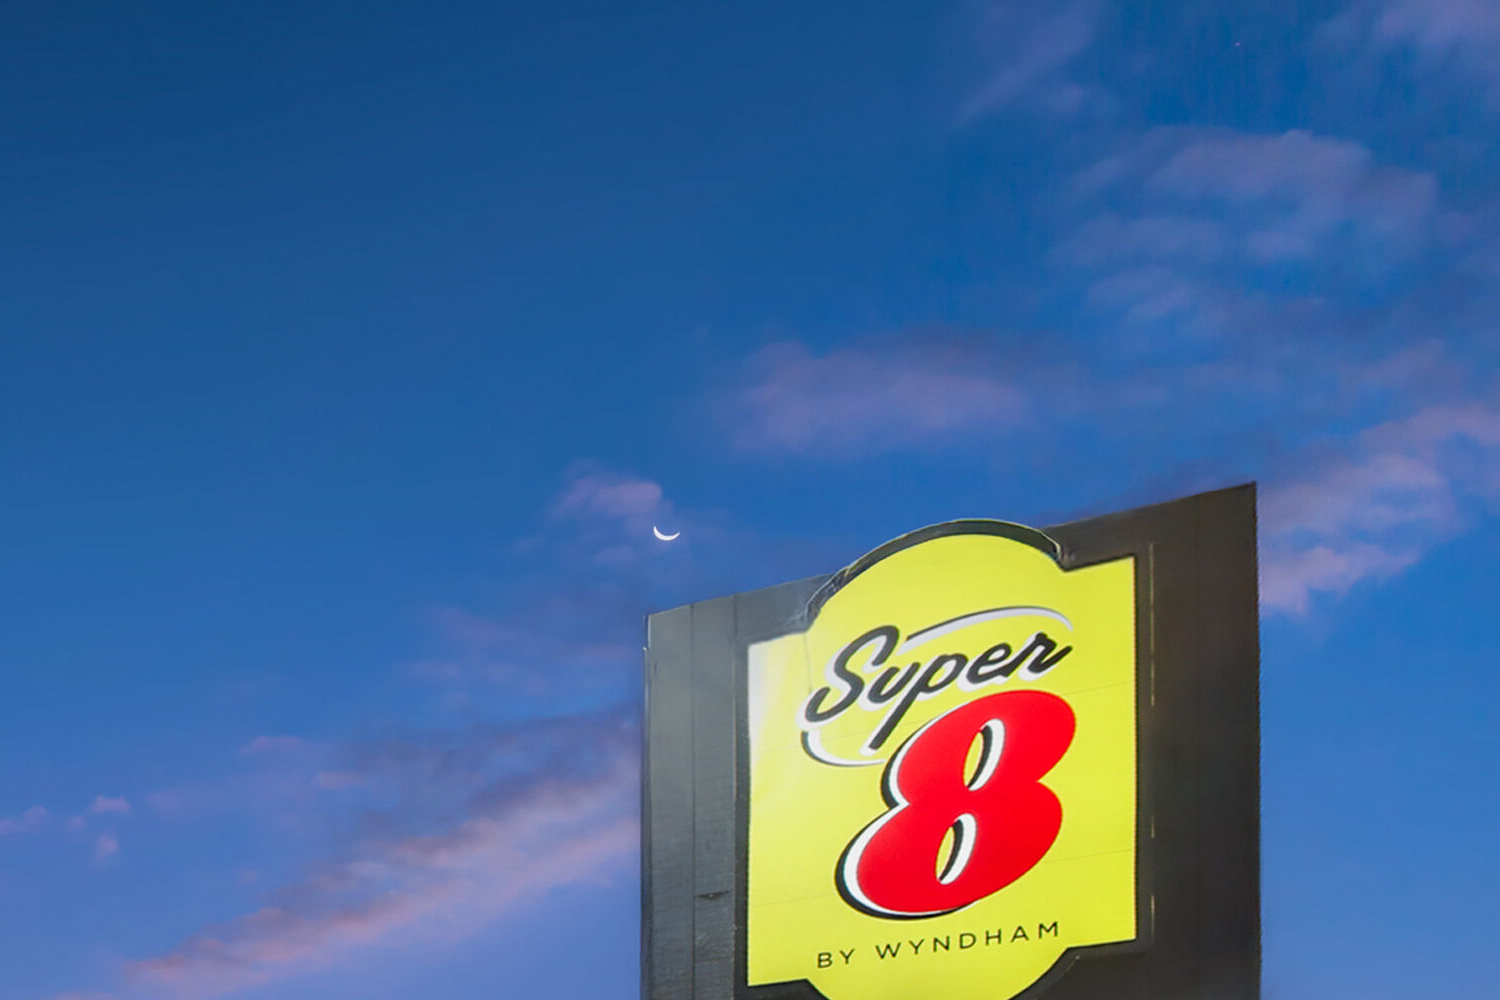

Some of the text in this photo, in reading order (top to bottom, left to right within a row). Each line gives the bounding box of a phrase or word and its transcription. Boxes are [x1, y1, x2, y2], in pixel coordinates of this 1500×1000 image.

[802, 625, 1074, 753] Super
[834, 689, 1077, 921] 8
[816, 921, 1060, 969] BY WYNDHAM
